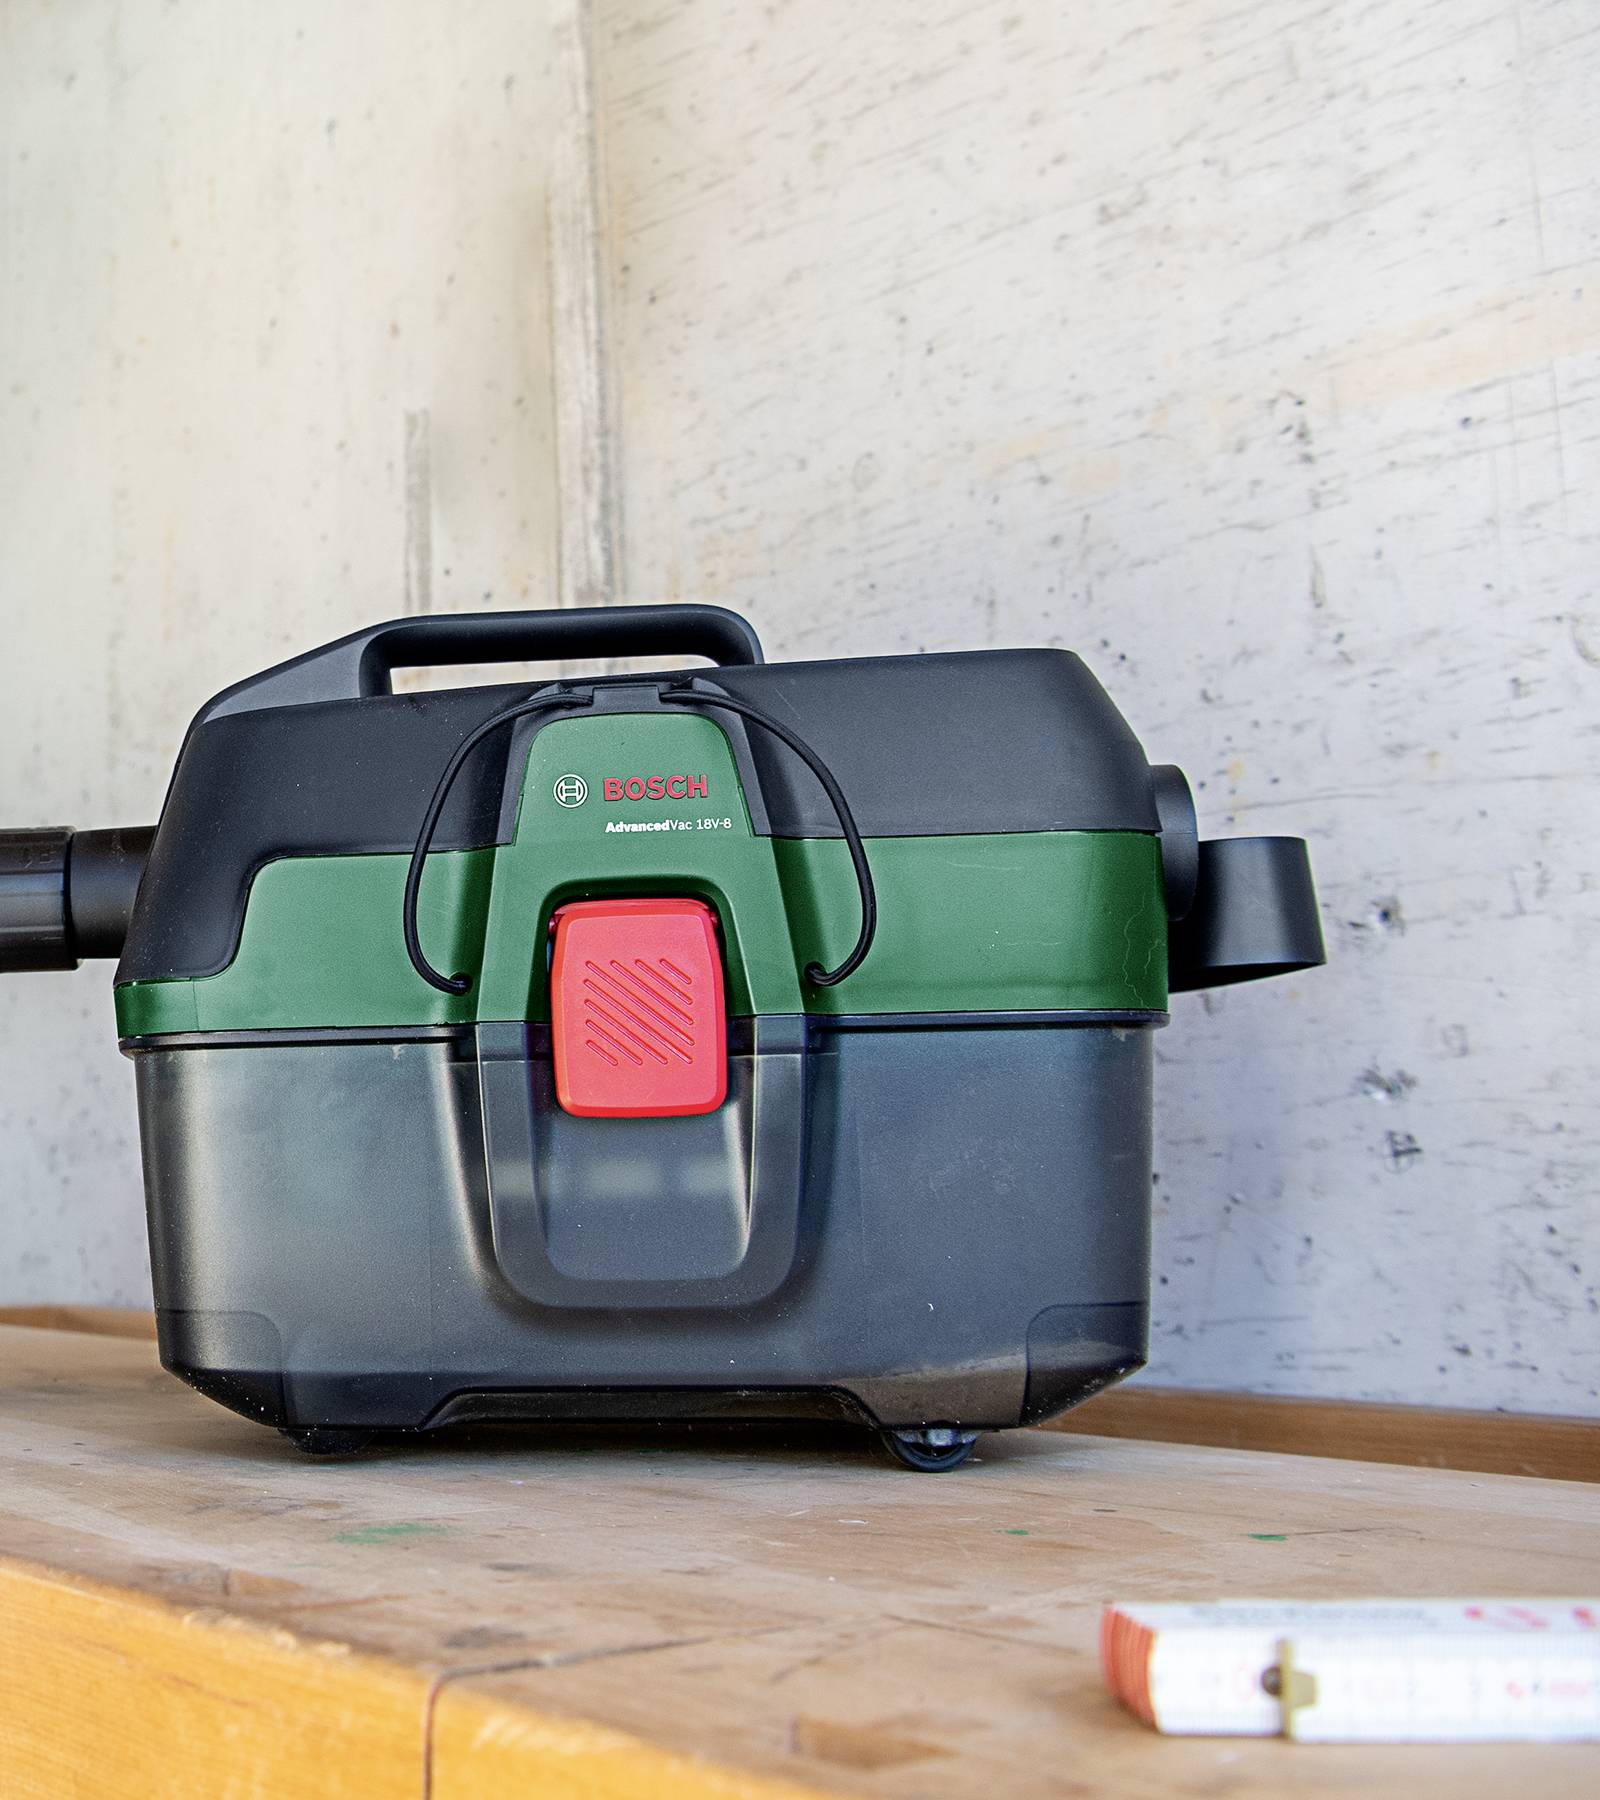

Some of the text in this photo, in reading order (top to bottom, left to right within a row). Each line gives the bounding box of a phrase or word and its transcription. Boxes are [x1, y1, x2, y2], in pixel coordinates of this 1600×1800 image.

[603, 774, 708, 801] BOSCH
[605, 818, 732, 833] AdvancedVac 18V-8
